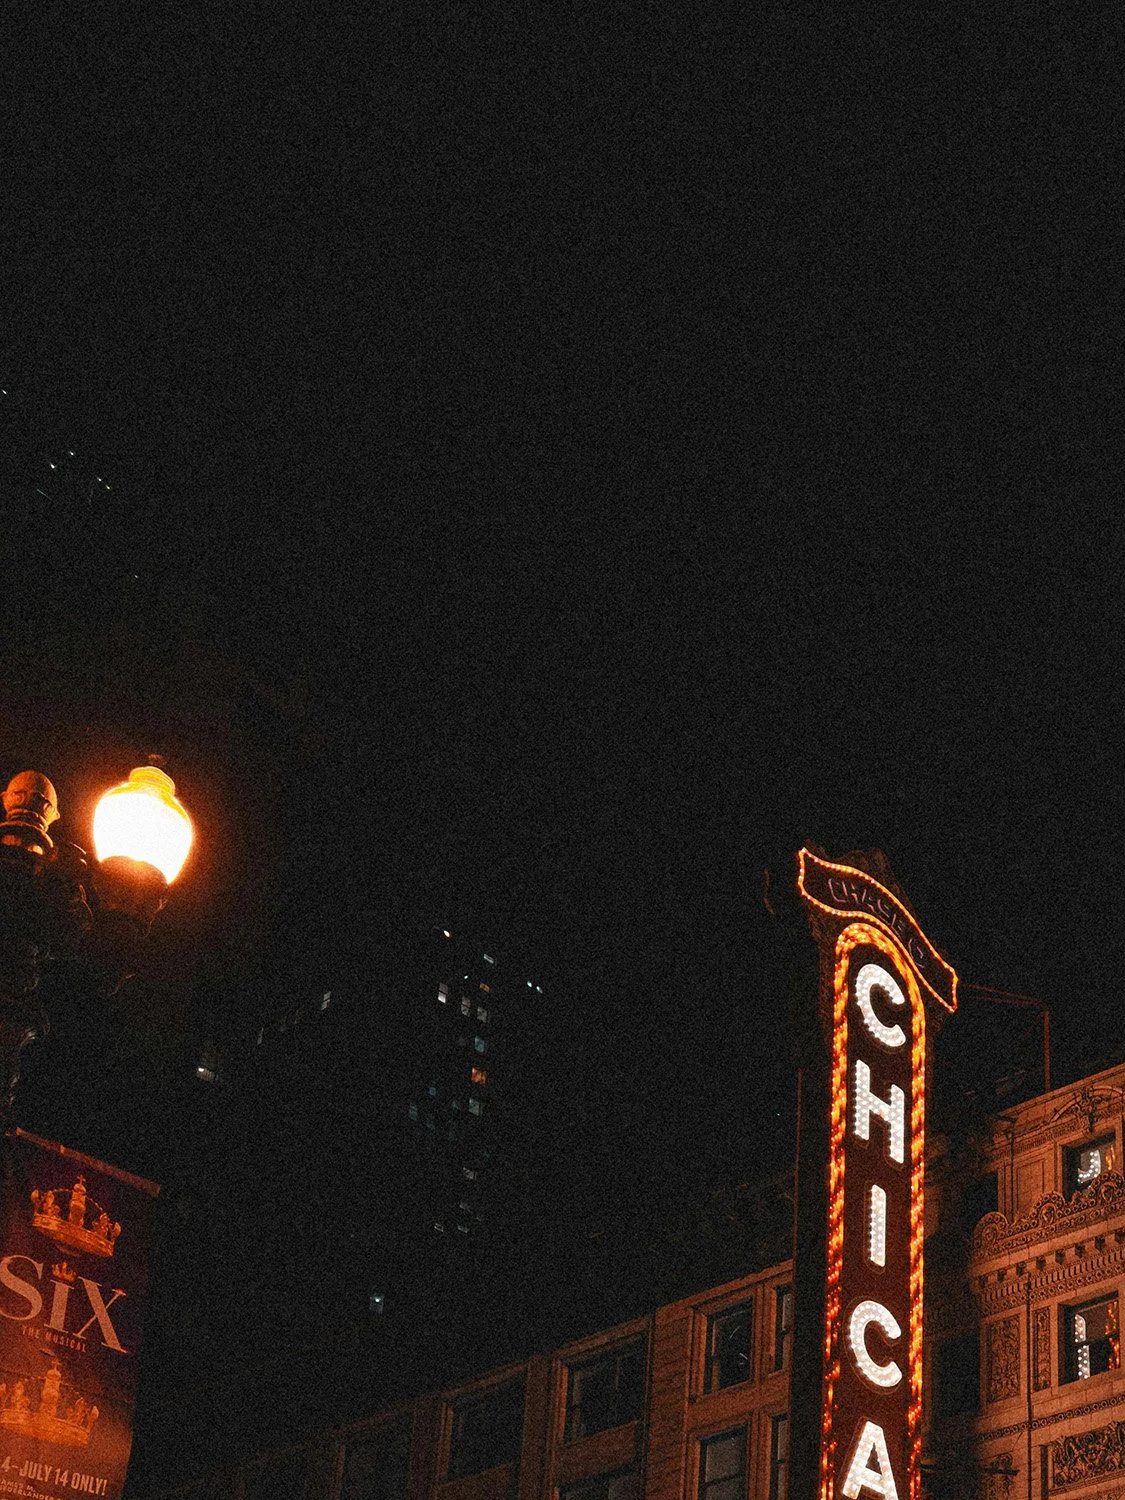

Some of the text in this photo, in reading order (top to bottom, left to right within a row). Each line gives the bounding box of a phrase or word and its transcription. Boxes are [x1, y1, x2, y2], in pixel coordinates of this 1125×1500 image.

[0, 1254, 128, 1354] SIX
[22, 1325, 87, 1353] THE MUSICAL
[54, 1468, 69, 1487] 14
[71, 1472, 108, 1496] ONLY!
